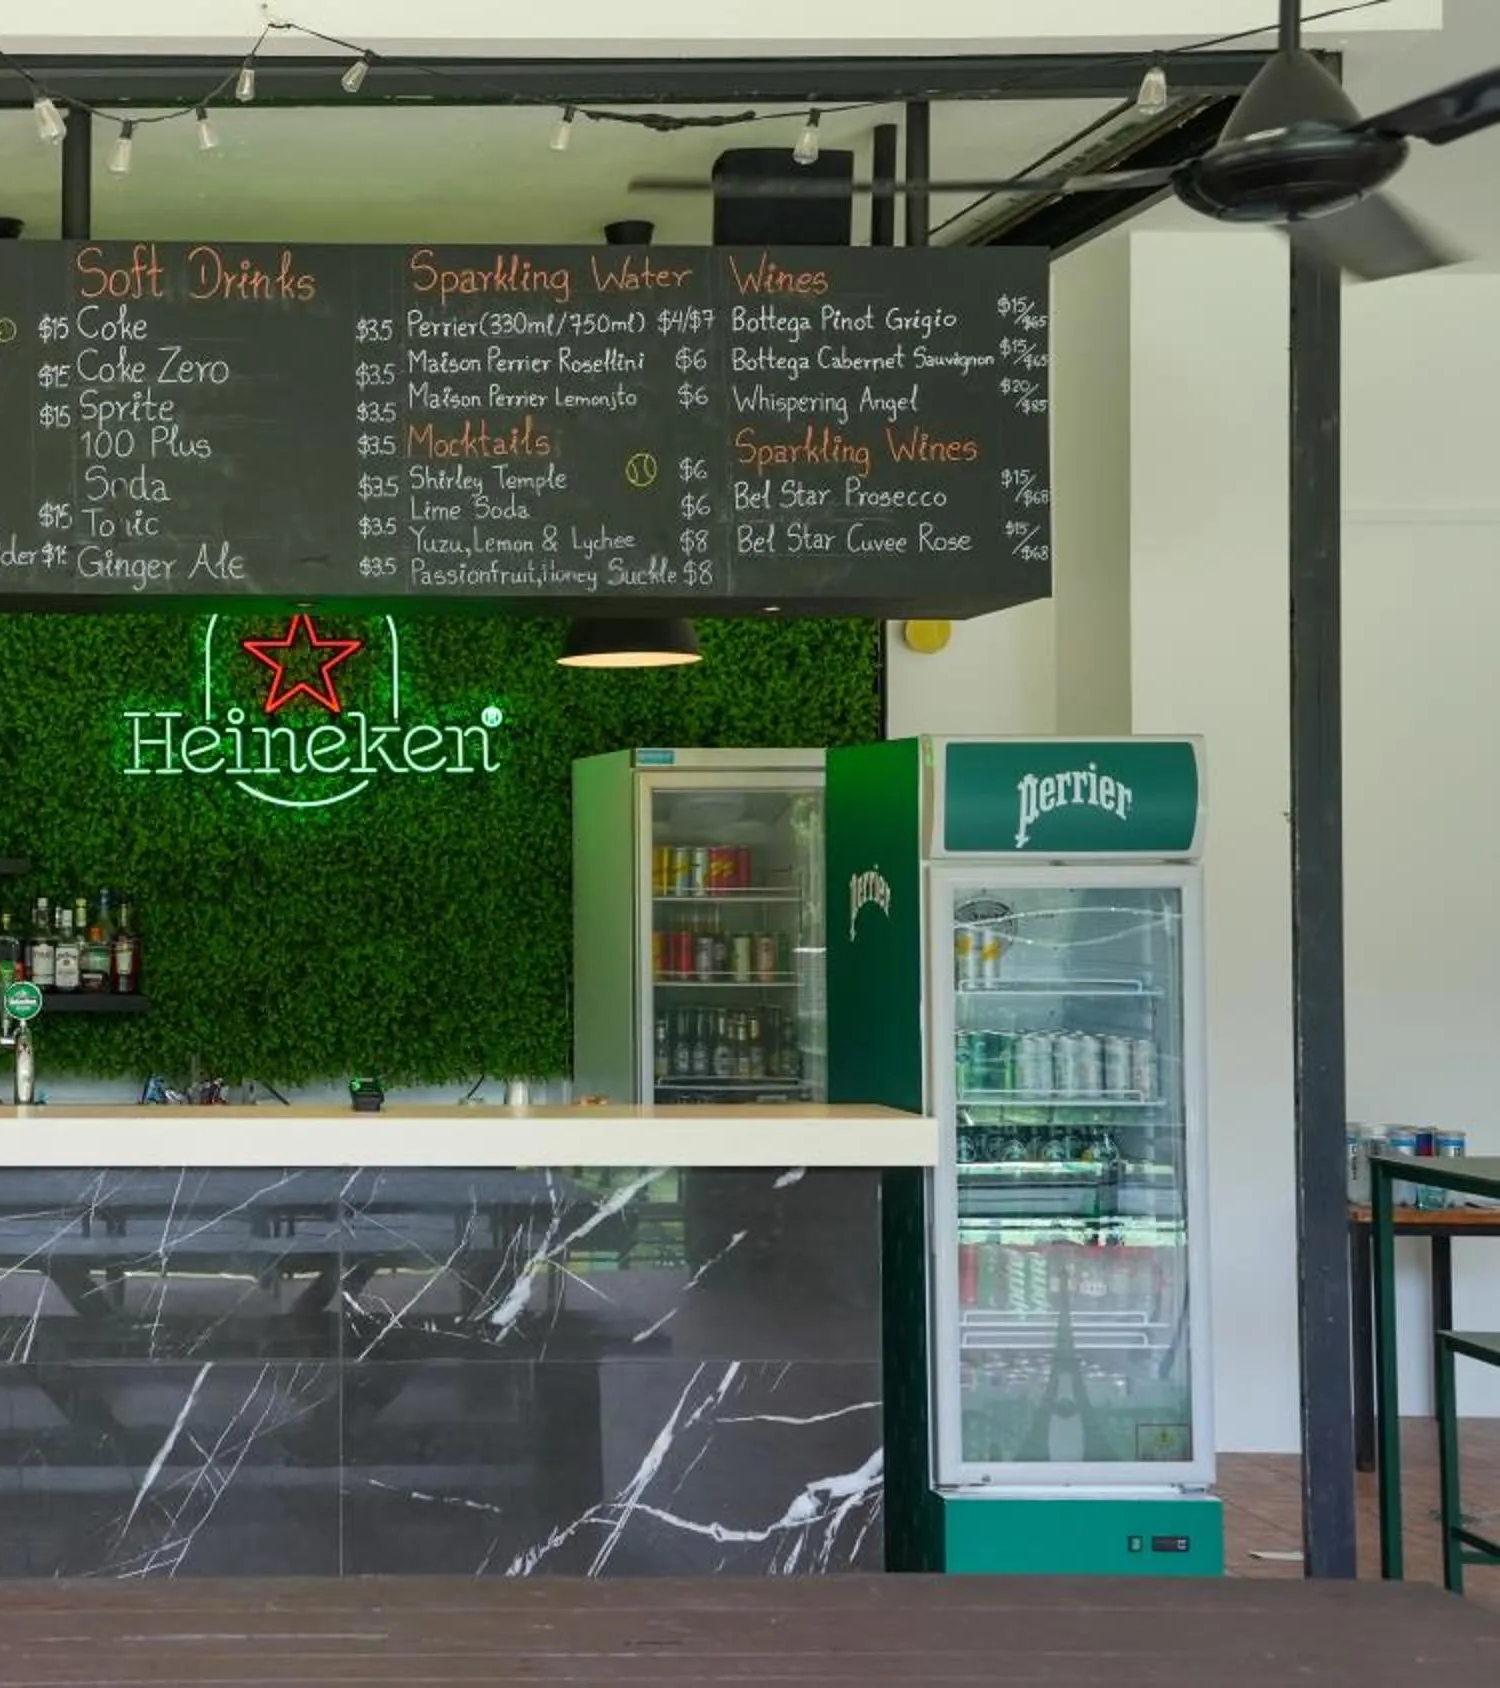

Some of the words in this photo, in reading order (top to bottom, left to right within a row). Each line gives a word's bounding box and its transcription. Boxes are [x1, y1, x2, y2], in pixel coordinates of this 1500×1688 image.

[76, 243, 164, 299] Soft
[188, 246, 316, 300] Drinks
[410, 249, 570, 305] Sparkling
[590, 255, 693, 294] Water
[729, 251, 829, 296] Wines
[38, 314, 69, 344] $15
[76, 304, 148, 341] Coke
[355, 316, 393, 343] $3.5
[731, 305, 812, 343] Bottega
[820, 304, 875, 332] Pinot
[885, 305, 957, 340] Grigio
[37, 362, 71, 391] $15
[76, 345, 146, 384] Coke
[157, 345, 230, 384] Zero
[355, 361, 397, 391] $3.5
[407, 349, 481, 374] Maison
[486, 345, 552, 374] Perrier
[559, 346, 645, 374] Rosellini
[675, 348, 708, 375] $6
[731, 345, 810, 381] Bottega
[817, 343, 905, 371] Cabernet
[913, 347, 995, 376] Sauvignon
[78, 387, 175, 430] Sprite
[356, 401, 397, 423] $3.5
[407, 381, 482, 409] Maison
[488, 383, 548, 409] Perrier
[677, 383, 709, 409] $6
[732, 383, 849, 425] Whispering
[859, 383, 919, 423] Angel
[39, 402, 71, 430] $15
[80, 429, 136, 458] 100
[151, 425, 213, 458] Plus
[357, 433, 396, 458] $3.5
[407, 415, 551, 458] Mocktails
[734, 425, 871, 479] Sparkling
[885, 425, 979, 463] Wines
[357, 472, 399, 501] $3.5
[408, 463, 484, 495] Shirley
[491, 463, 567, 495] Temple
[679, 457, 708, 483] $6
[734, 479, 771, 510] Bel
[780, 479, 832, 508] Star
[844, 475, 948, 507] Prosecco
[38, 501, 73, 529] $15
[410, 496, 461, 521] Lime
[475, 494, 530, 520] Soda
[681, 492, 712, 519] $6
[358, 514, 397, 539] $3.5
[542, 524, 558, 553] &
[571, 524, 636, 560] Lychee
[680, 528, 709, 556] $8
[737, 522, 775, 554] Bel
[786, 521, 836, 552] Star
[847, 522, 908, 554] Cuvee
[918, 521, 973, 553] Rose
[77, 545, 177, 592] Ginger
[187, 541, 246, 580] Ale
[359, 556, 397, 578] $3.5
[607, 556, 677, 586] Suckle
[683, 559, 713, 587] $8
[124, 707, 500, 774] Heineken
[1015, 762, 1134, 849] perrier
